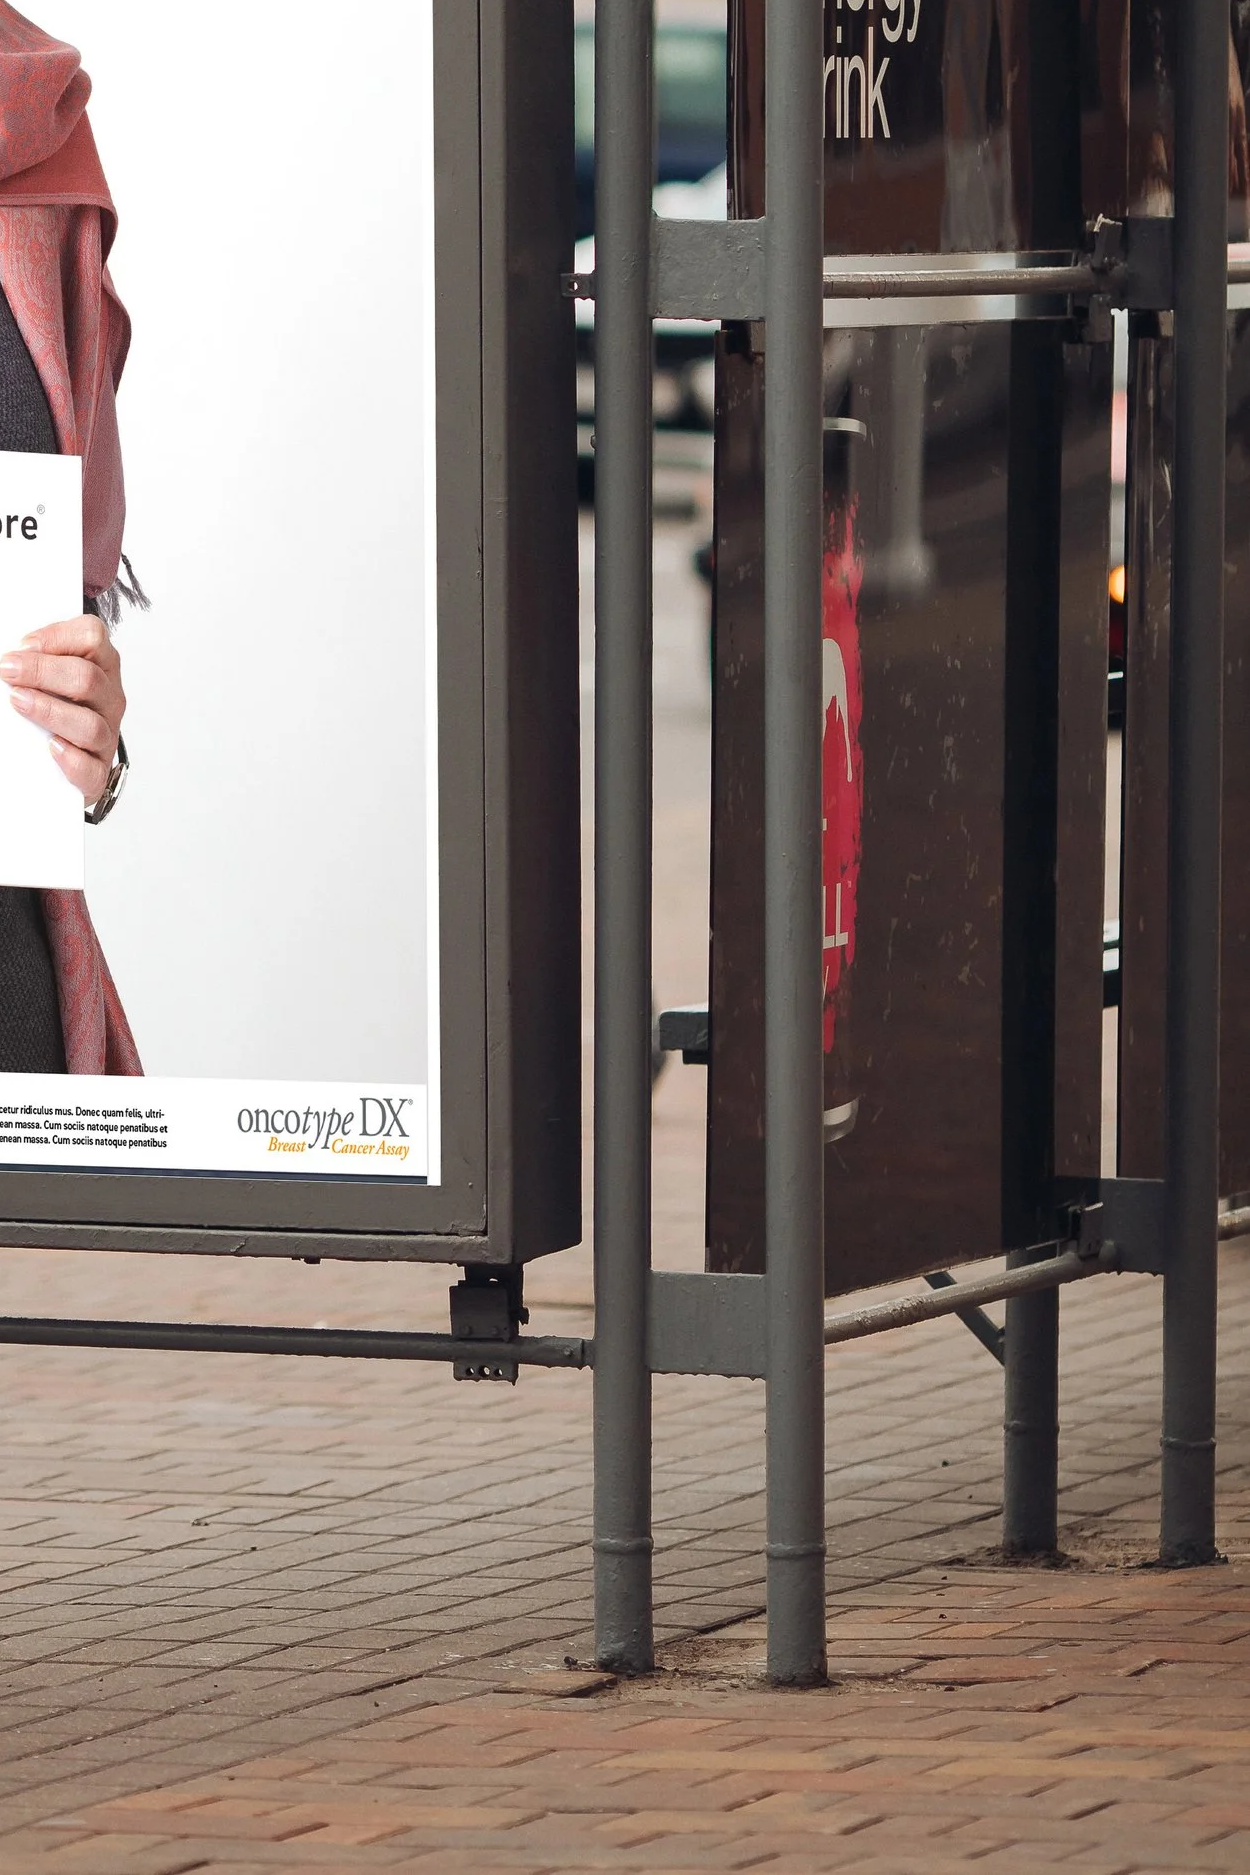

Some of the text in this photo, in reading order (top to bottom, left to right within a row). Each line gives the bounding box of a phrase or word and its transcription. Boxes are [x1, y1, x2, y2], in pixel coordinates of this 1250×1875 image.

[823, 26, 891, 139] rink
[237, 1106, 355, 1150] oncotype
[267, 1136, 410, 1161] Breast Cancer Assay
